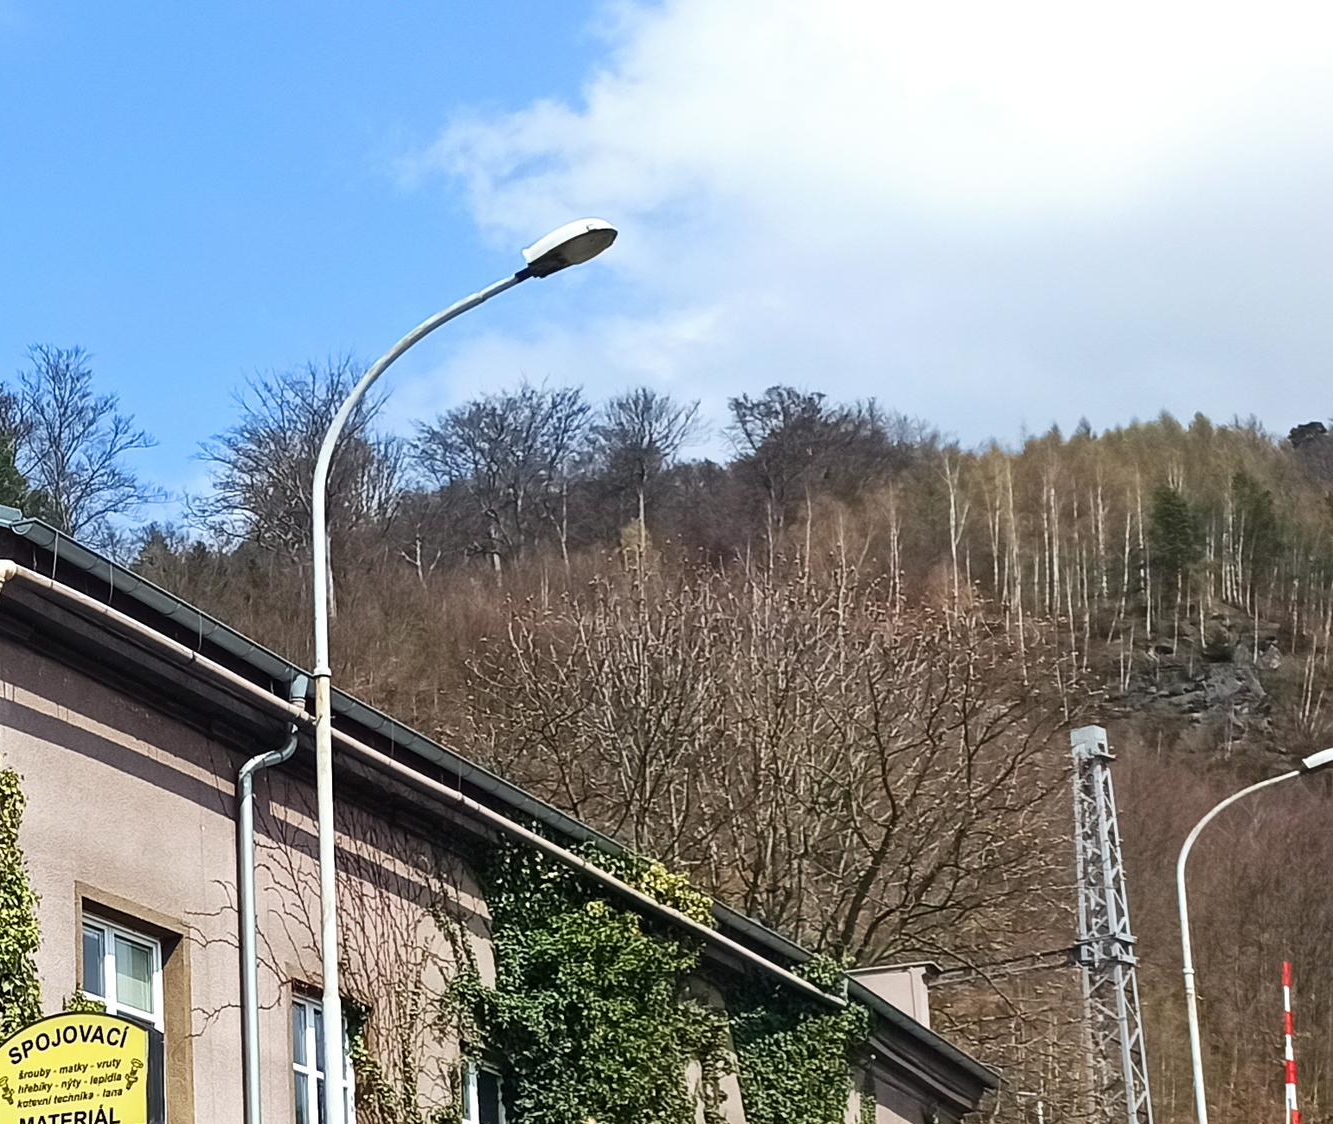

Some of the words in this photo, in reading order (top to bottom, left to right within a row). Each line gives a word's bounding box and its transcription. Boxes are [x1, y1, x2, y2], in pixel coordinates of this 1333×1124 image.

[8, 1023, 130, 1065] SPOJOVACÍ
[18, 1067, 51, 1080] šrouby
[59, 1062, 88, 1074] matky
[96, 1058, 121, 1069] vruty
[61, 1078, 81, 1090] nýty
[89, 1073, 122, 1086] lepidla
[53, 1091, 94, 1104] technika
[102, 1088, 123, 1097] lana
